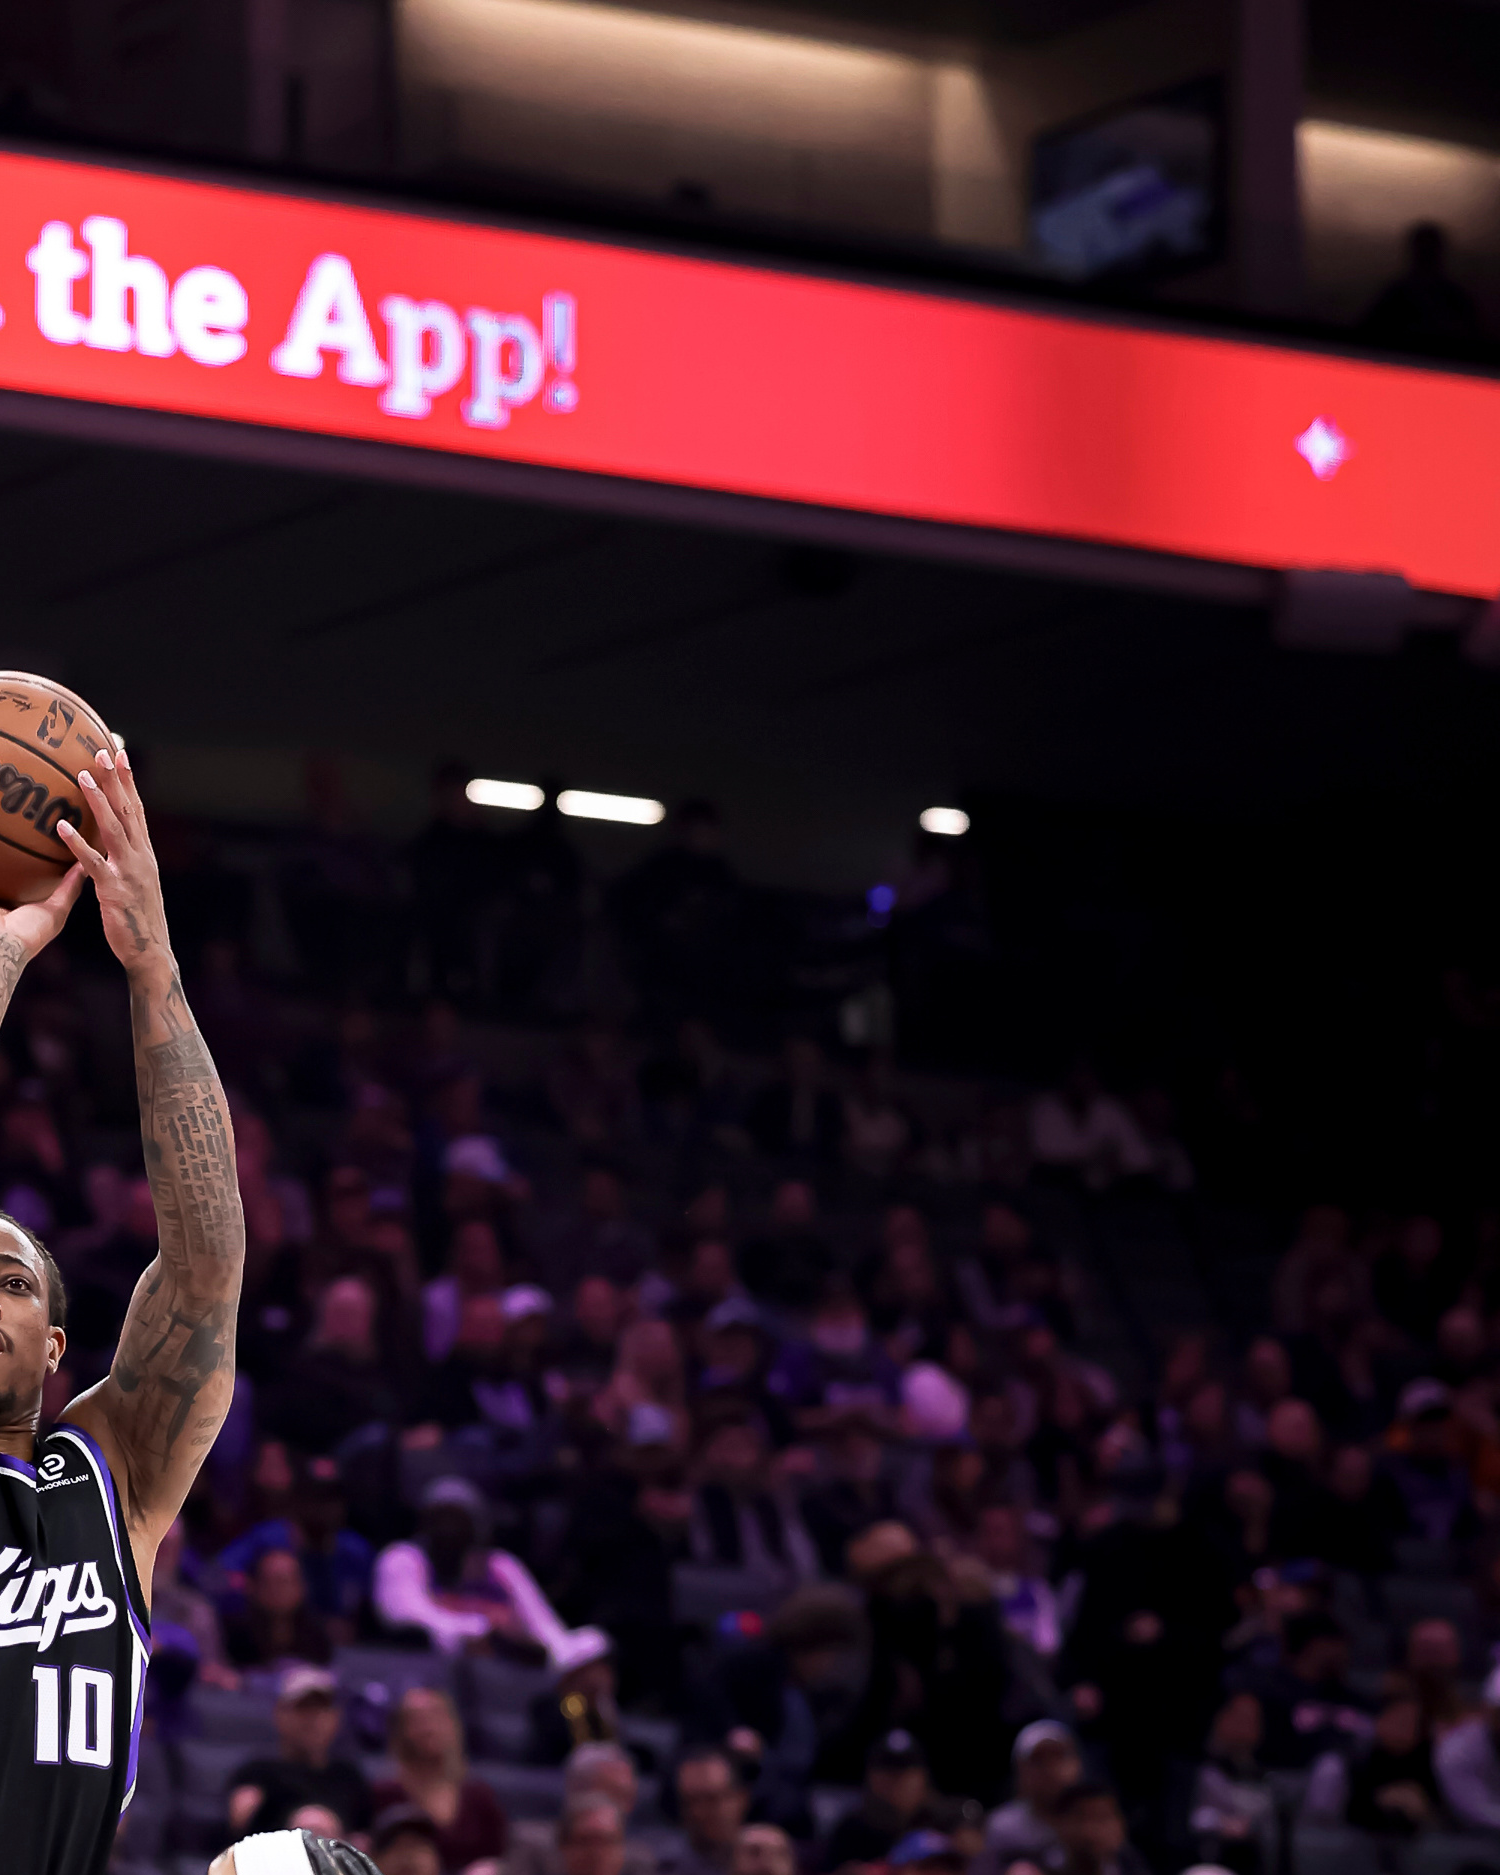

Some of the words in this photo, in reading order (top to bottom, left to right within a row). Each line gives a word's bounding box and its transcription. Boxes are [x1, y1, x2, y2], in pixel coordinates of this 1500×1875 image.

[27, 214, 250, 366] the
[272, 252, 580, 428] App!
[35, 1478, 71, 1493] PHOONG
[70, 1473, 89, 1484] LAW
[31, 1662, 115, 1771] 10
